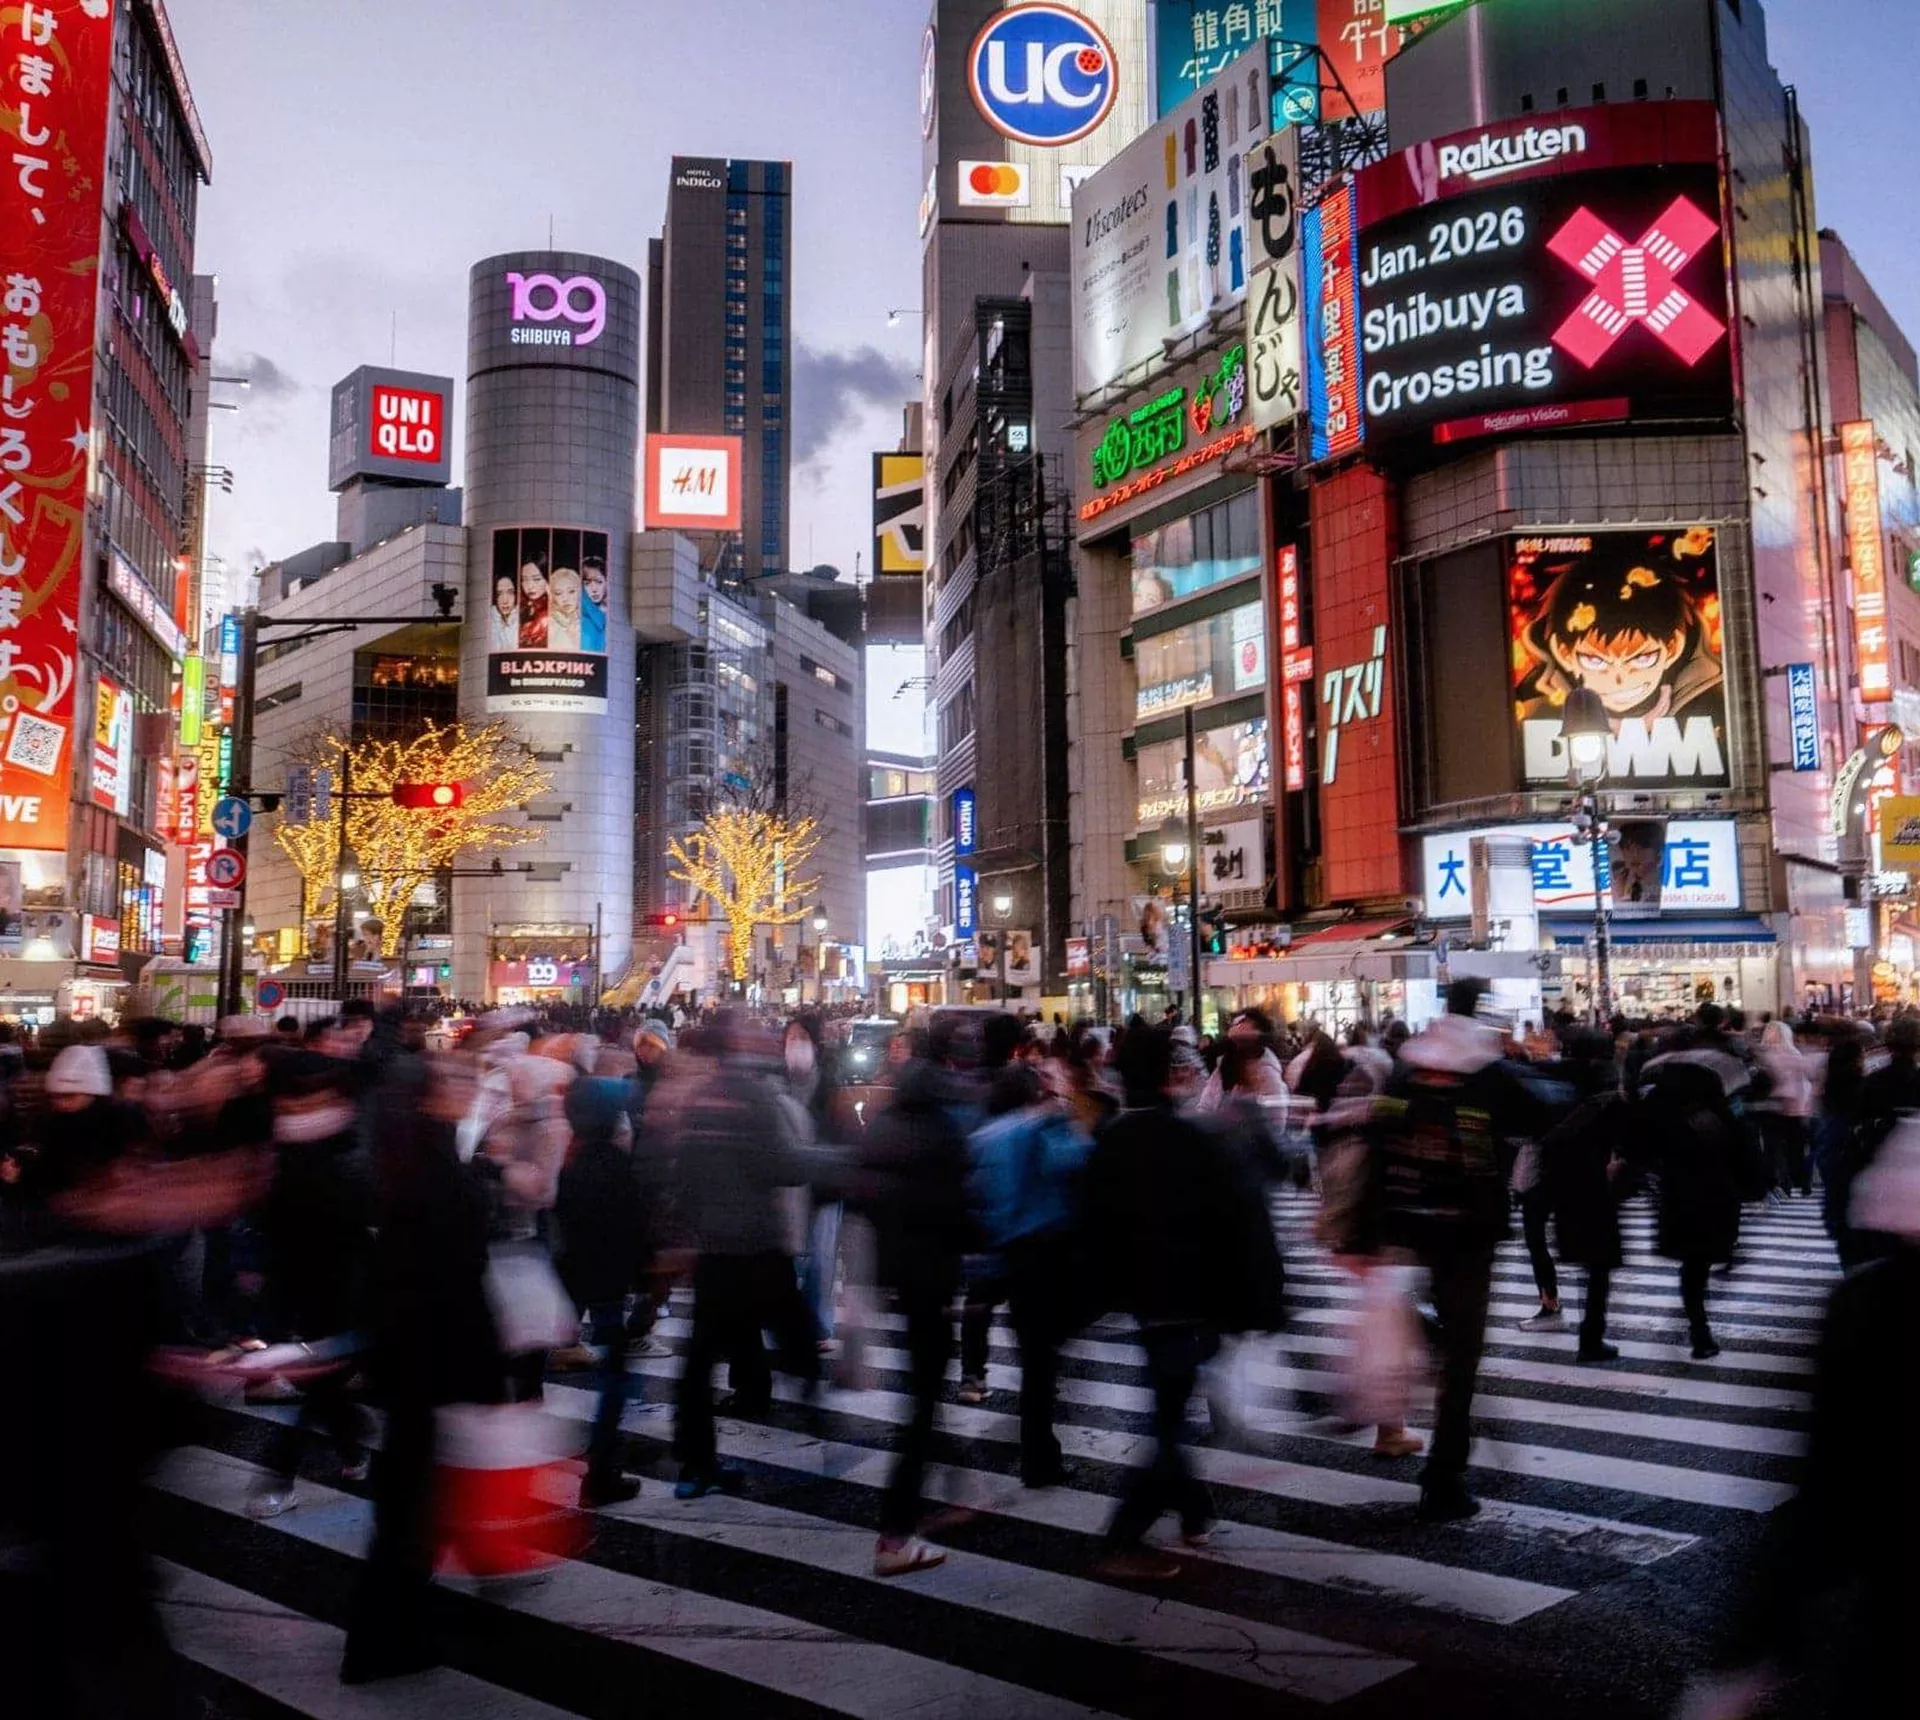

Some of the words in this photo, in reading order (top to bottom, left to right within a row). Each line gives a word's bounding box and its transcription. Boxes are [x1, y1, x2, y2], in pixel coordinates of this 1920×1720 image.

[1439, 123, 1587, 179] Rakuten
[676, 176, 722, 188] INDIGO
[1251, 146, 1300, 407] もんじゃ
[506, 272, 607, 346] 109
[510, 327, 571, 346] SHIBUYA
[1362, 281, 1525, 353] Shibuya
[1366, 344, 1554, 416] Crossing
[380, 394, 431, 425] UNI
[378, 423, 435, 454] QLO
[671, 467, 717, 497] H&M
[1323, 624, 1386, 784] クスリ
